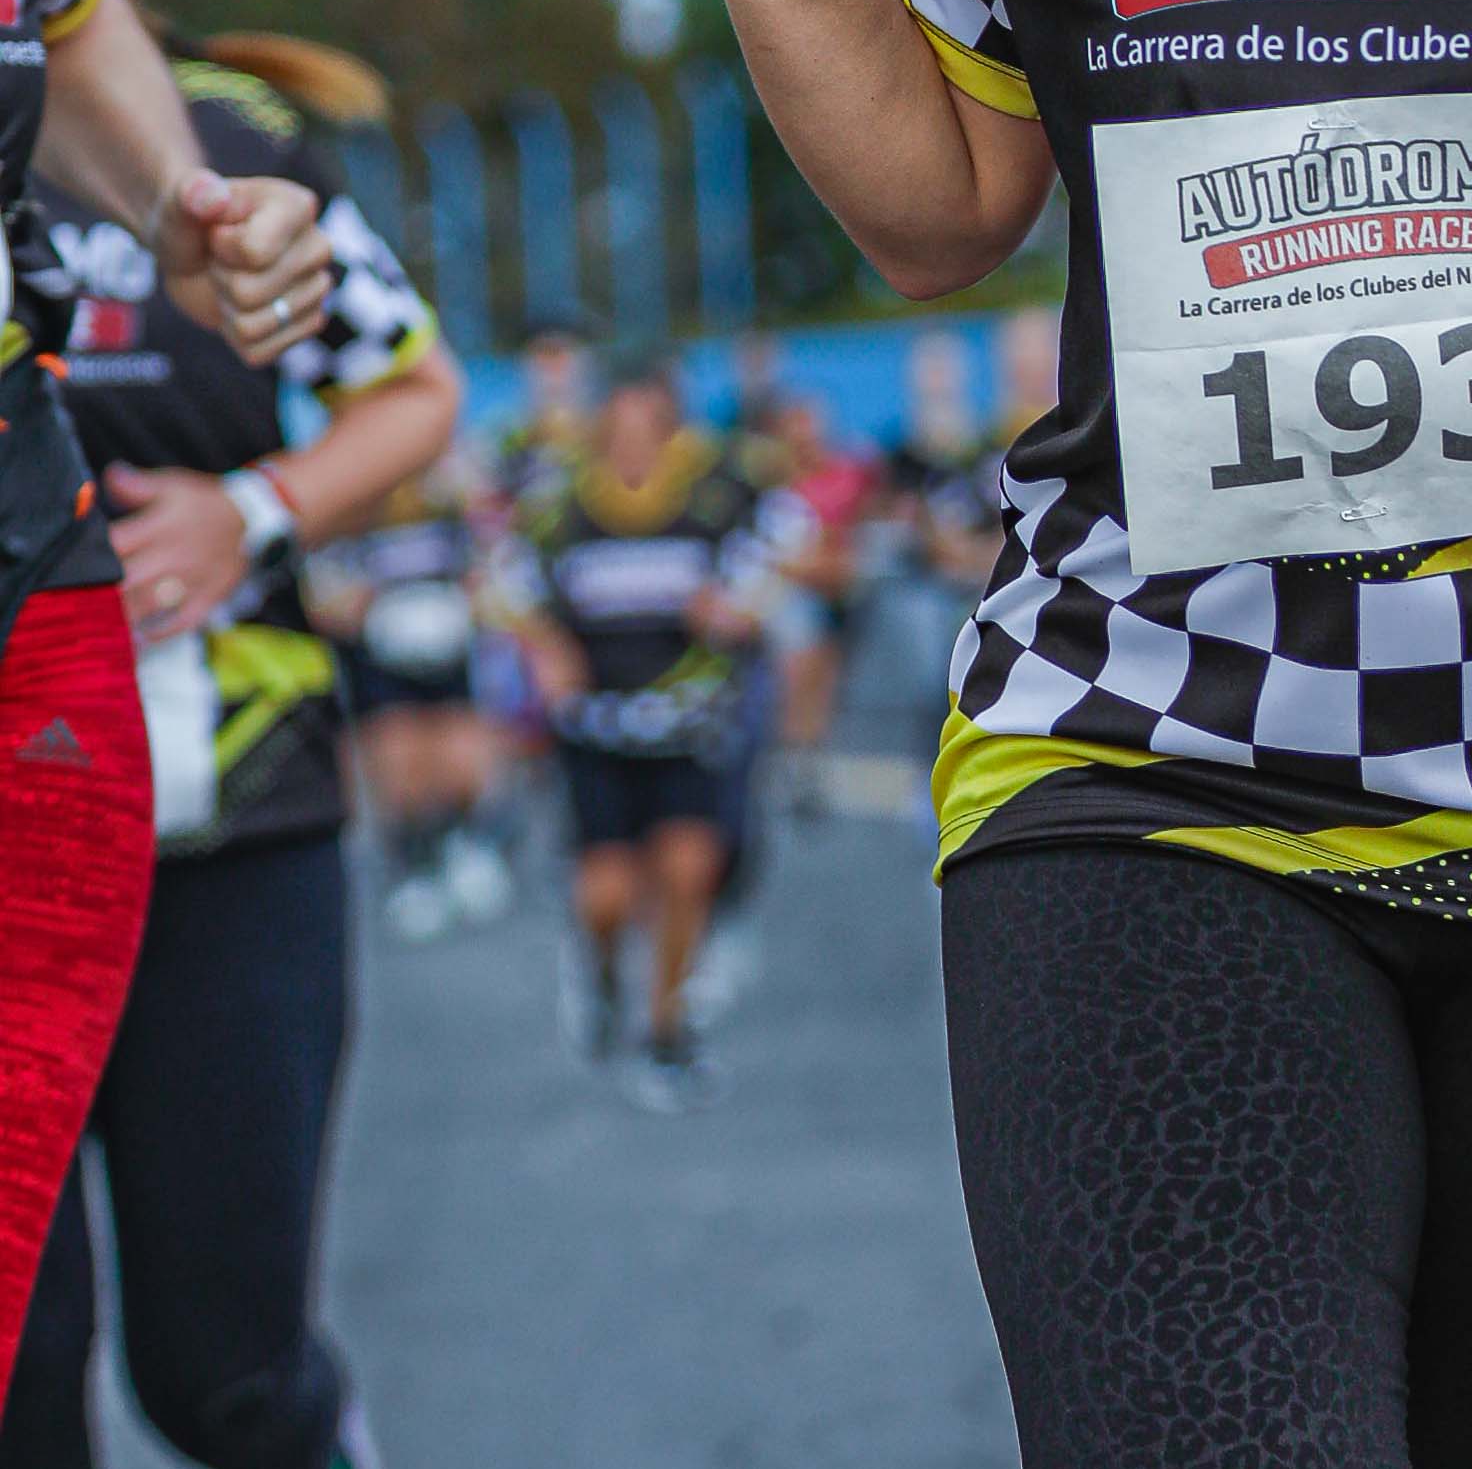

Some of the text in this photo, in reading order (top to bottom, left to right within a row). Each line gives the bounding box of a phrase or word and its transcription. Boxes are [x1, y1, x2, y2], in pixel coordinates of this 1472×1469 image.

[1086, 37, 1108, 71] La
[1111, 32, 1225, 67] Carrera
[1235, 24, 1285, 61] de
[1296, 25, 1349, 64] los
[1239, 218, 1384, 278] RUNNING
[1179, 299, 1203, 318] La
[1207, 296, 1282, 315] Carrera
[1286, 286, 1313, 306] de
[1316, 282, 1345, 302] los
[1349, 275, 1417, 298] Clubes
[1421, 266, 1451, 289] del
